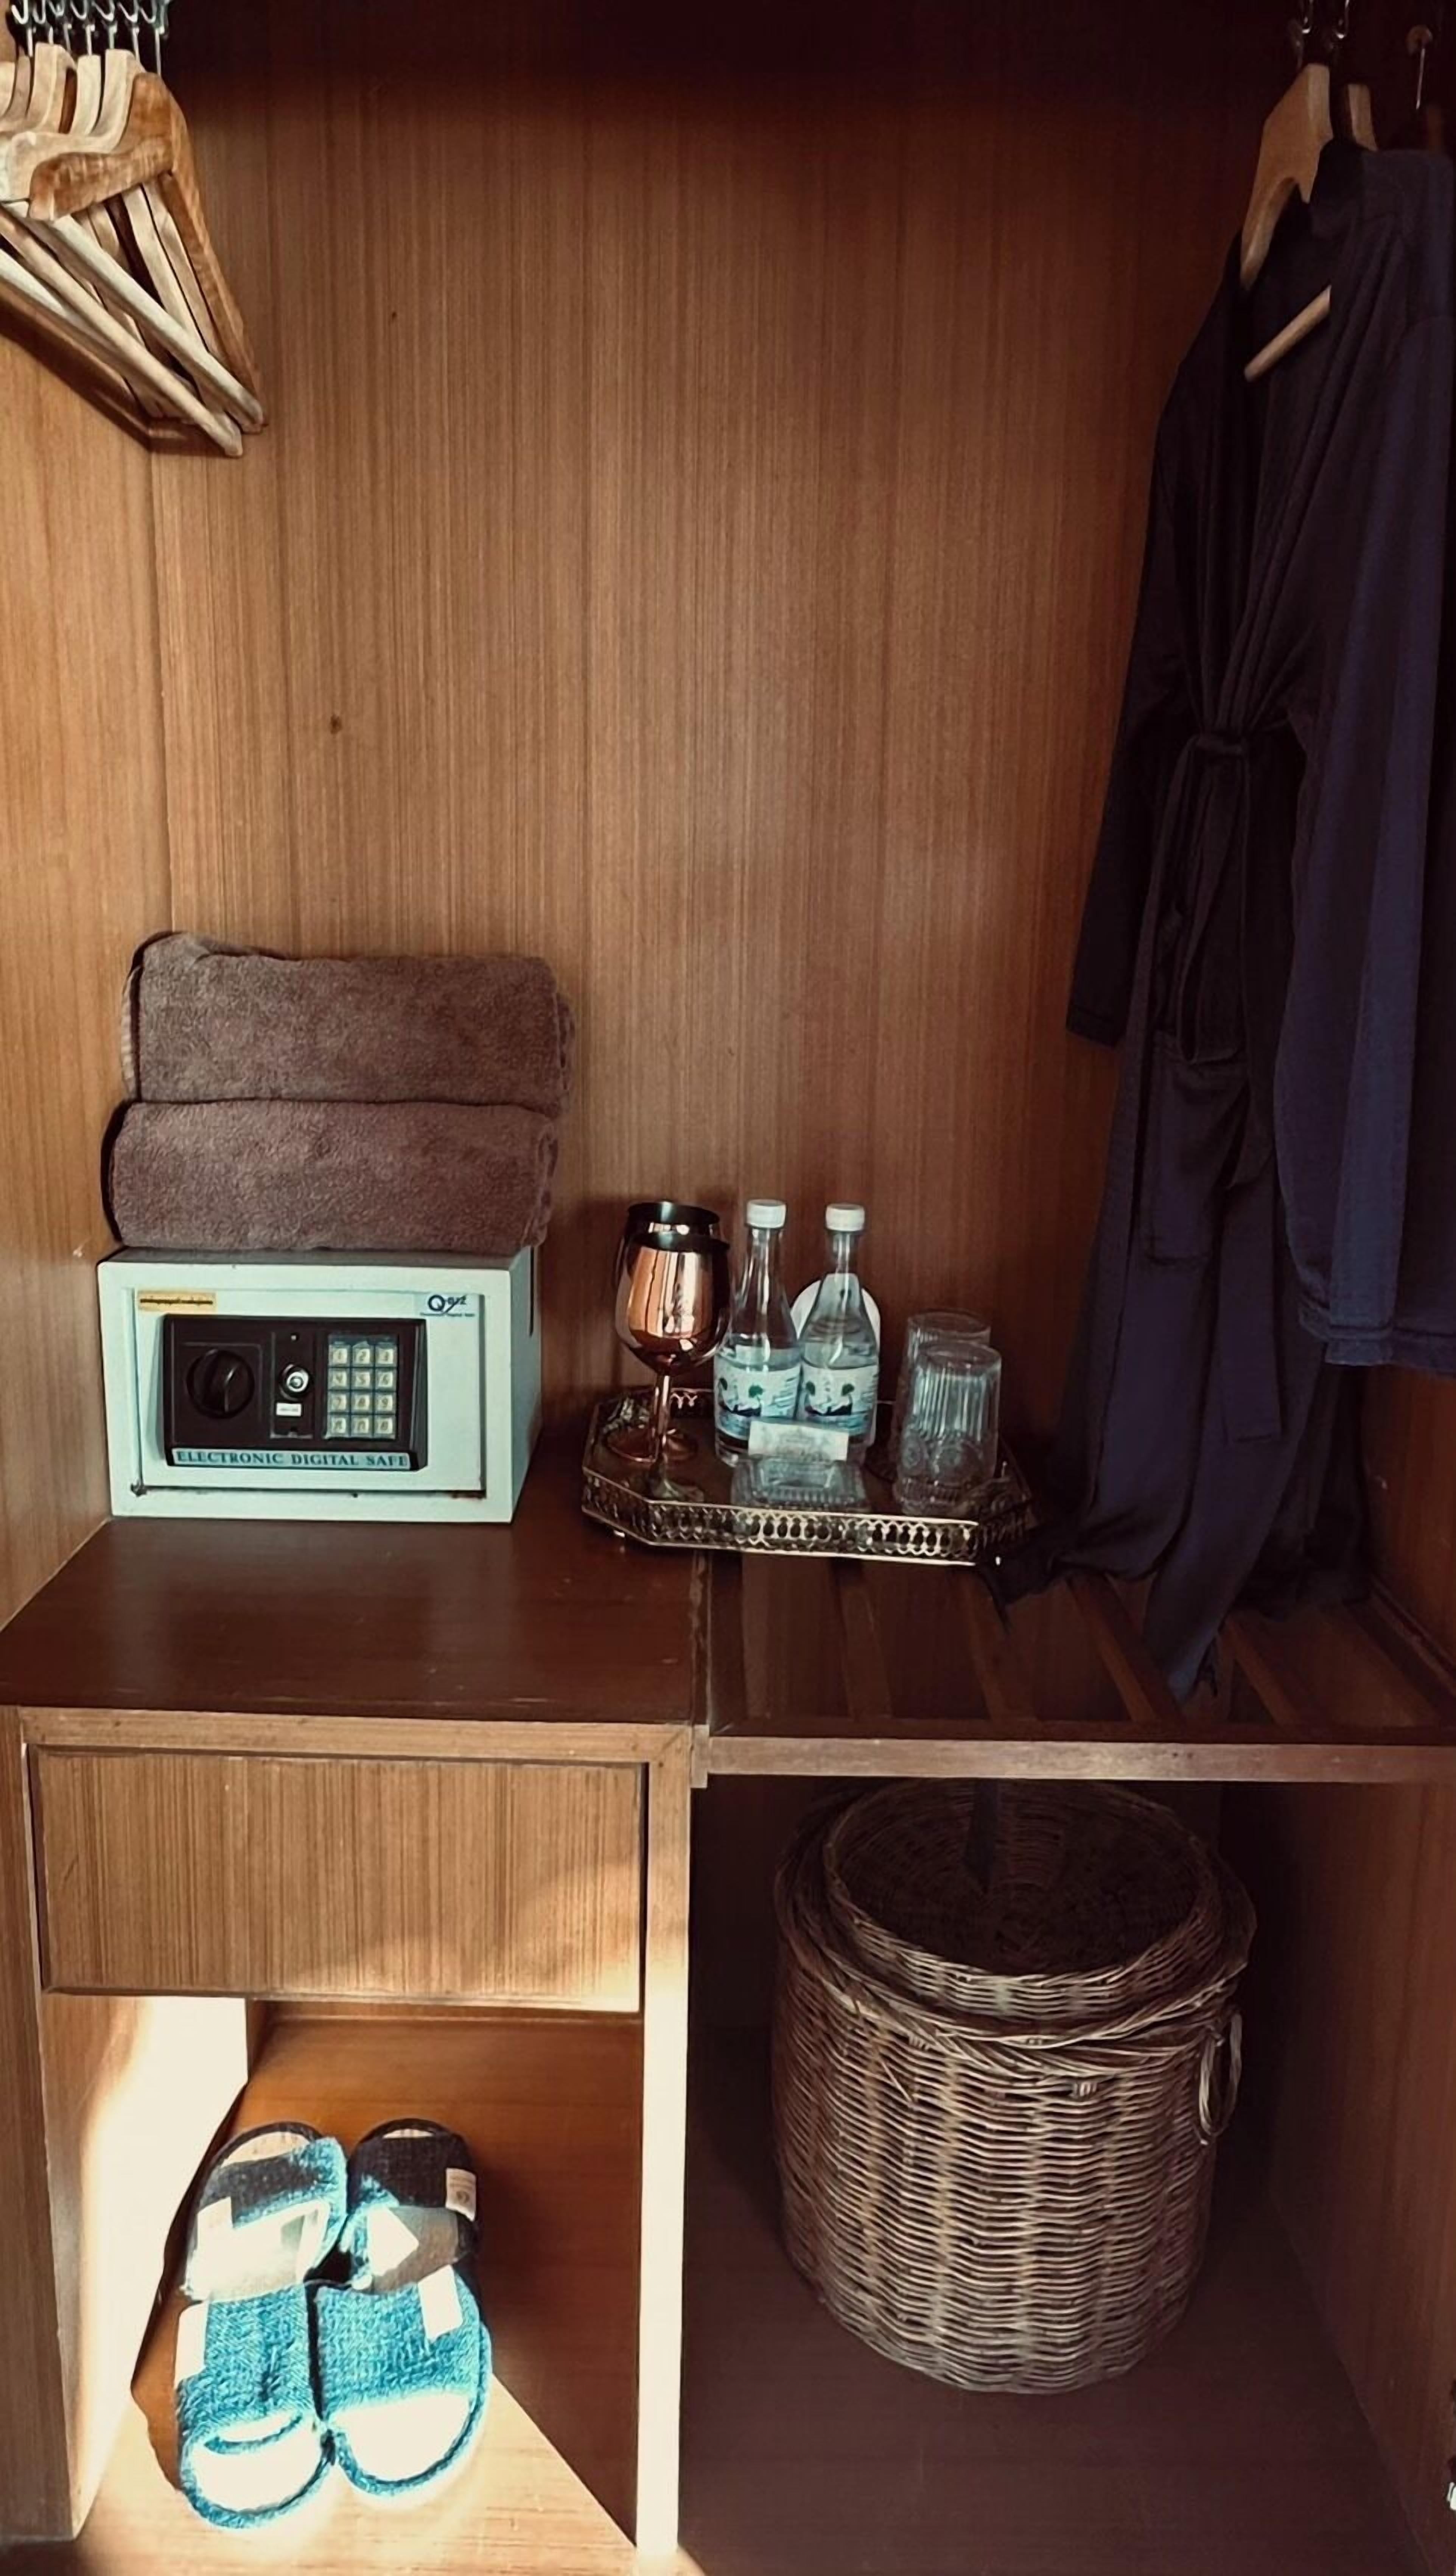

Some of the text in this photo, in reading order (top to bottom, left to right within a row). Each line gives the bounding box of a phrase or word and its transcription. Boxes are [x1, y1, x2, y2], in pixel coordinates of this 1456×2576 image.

[359, 1351, 367, 1361] 2
[176, 1451, 407, 1466] ELECTRONIC DIGITAL SAFE
